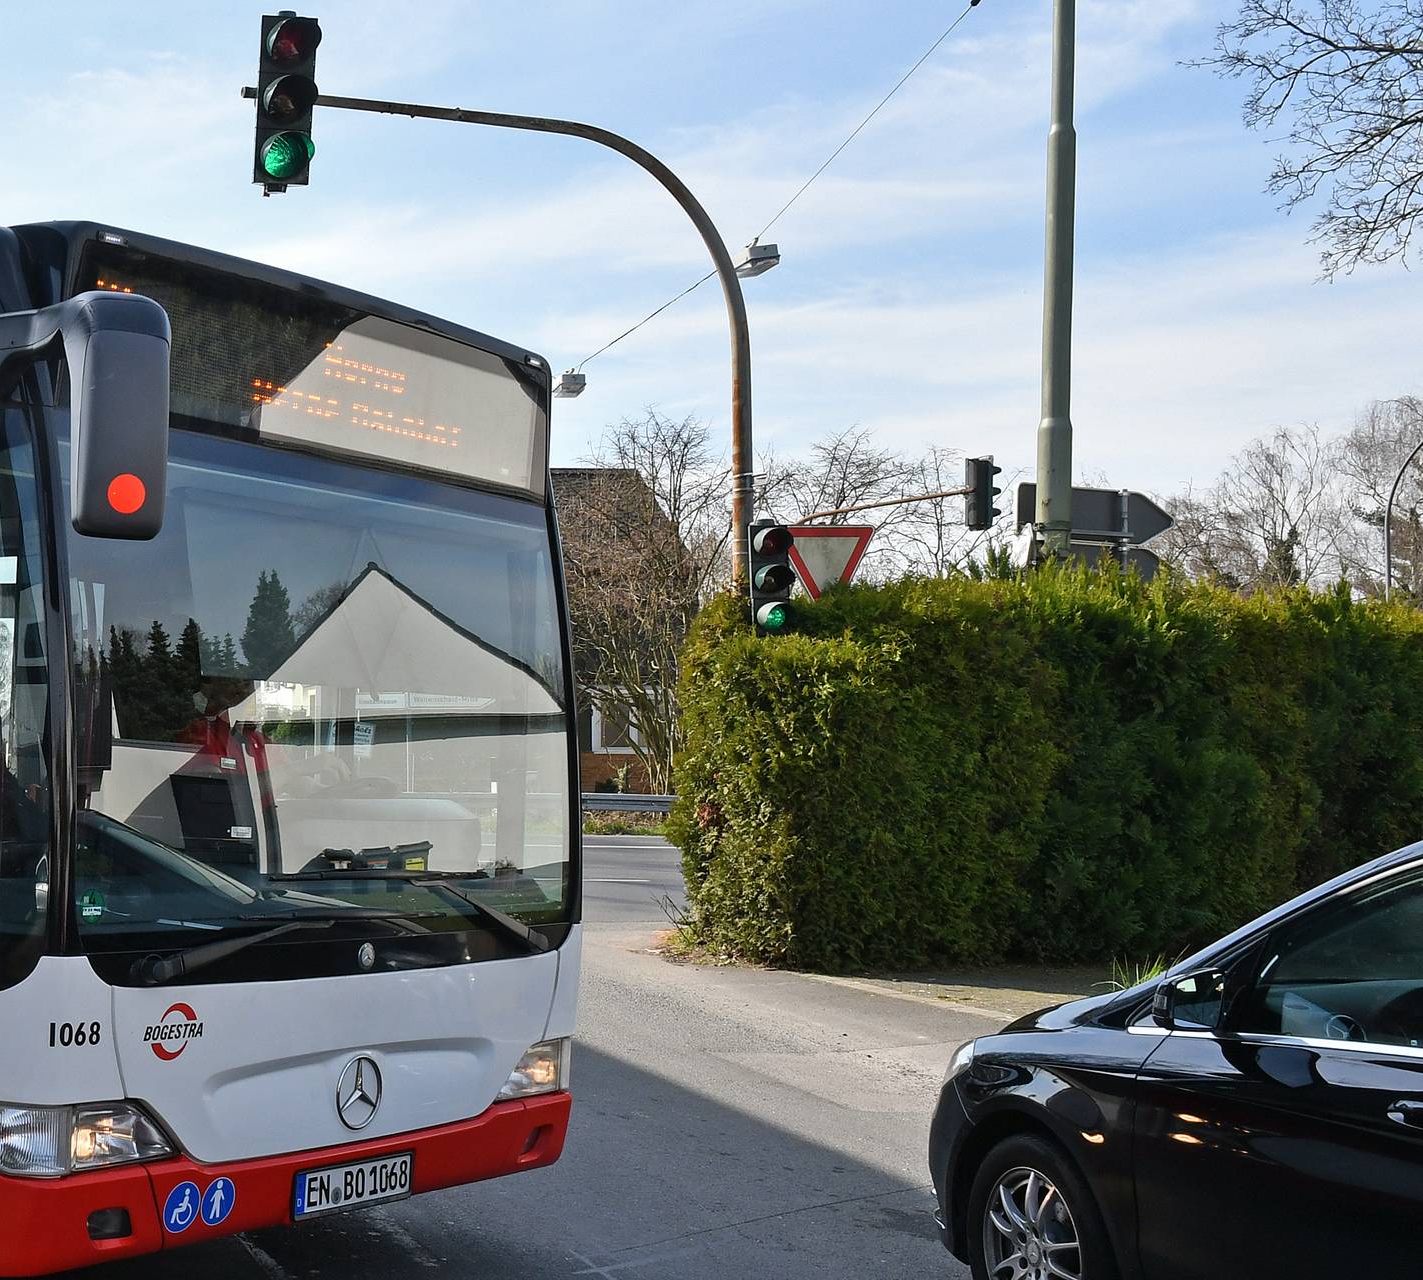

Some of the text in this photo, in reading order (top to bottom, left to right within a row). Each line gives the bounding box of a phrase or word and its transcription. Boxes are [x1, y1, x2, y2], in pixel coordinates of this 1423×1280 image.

[49, 1021, 101, 1047] 1068
[143, 1022, 204, 1042] BOGESTRA
[307, 1159, 408, 1208] EN BO 1068
